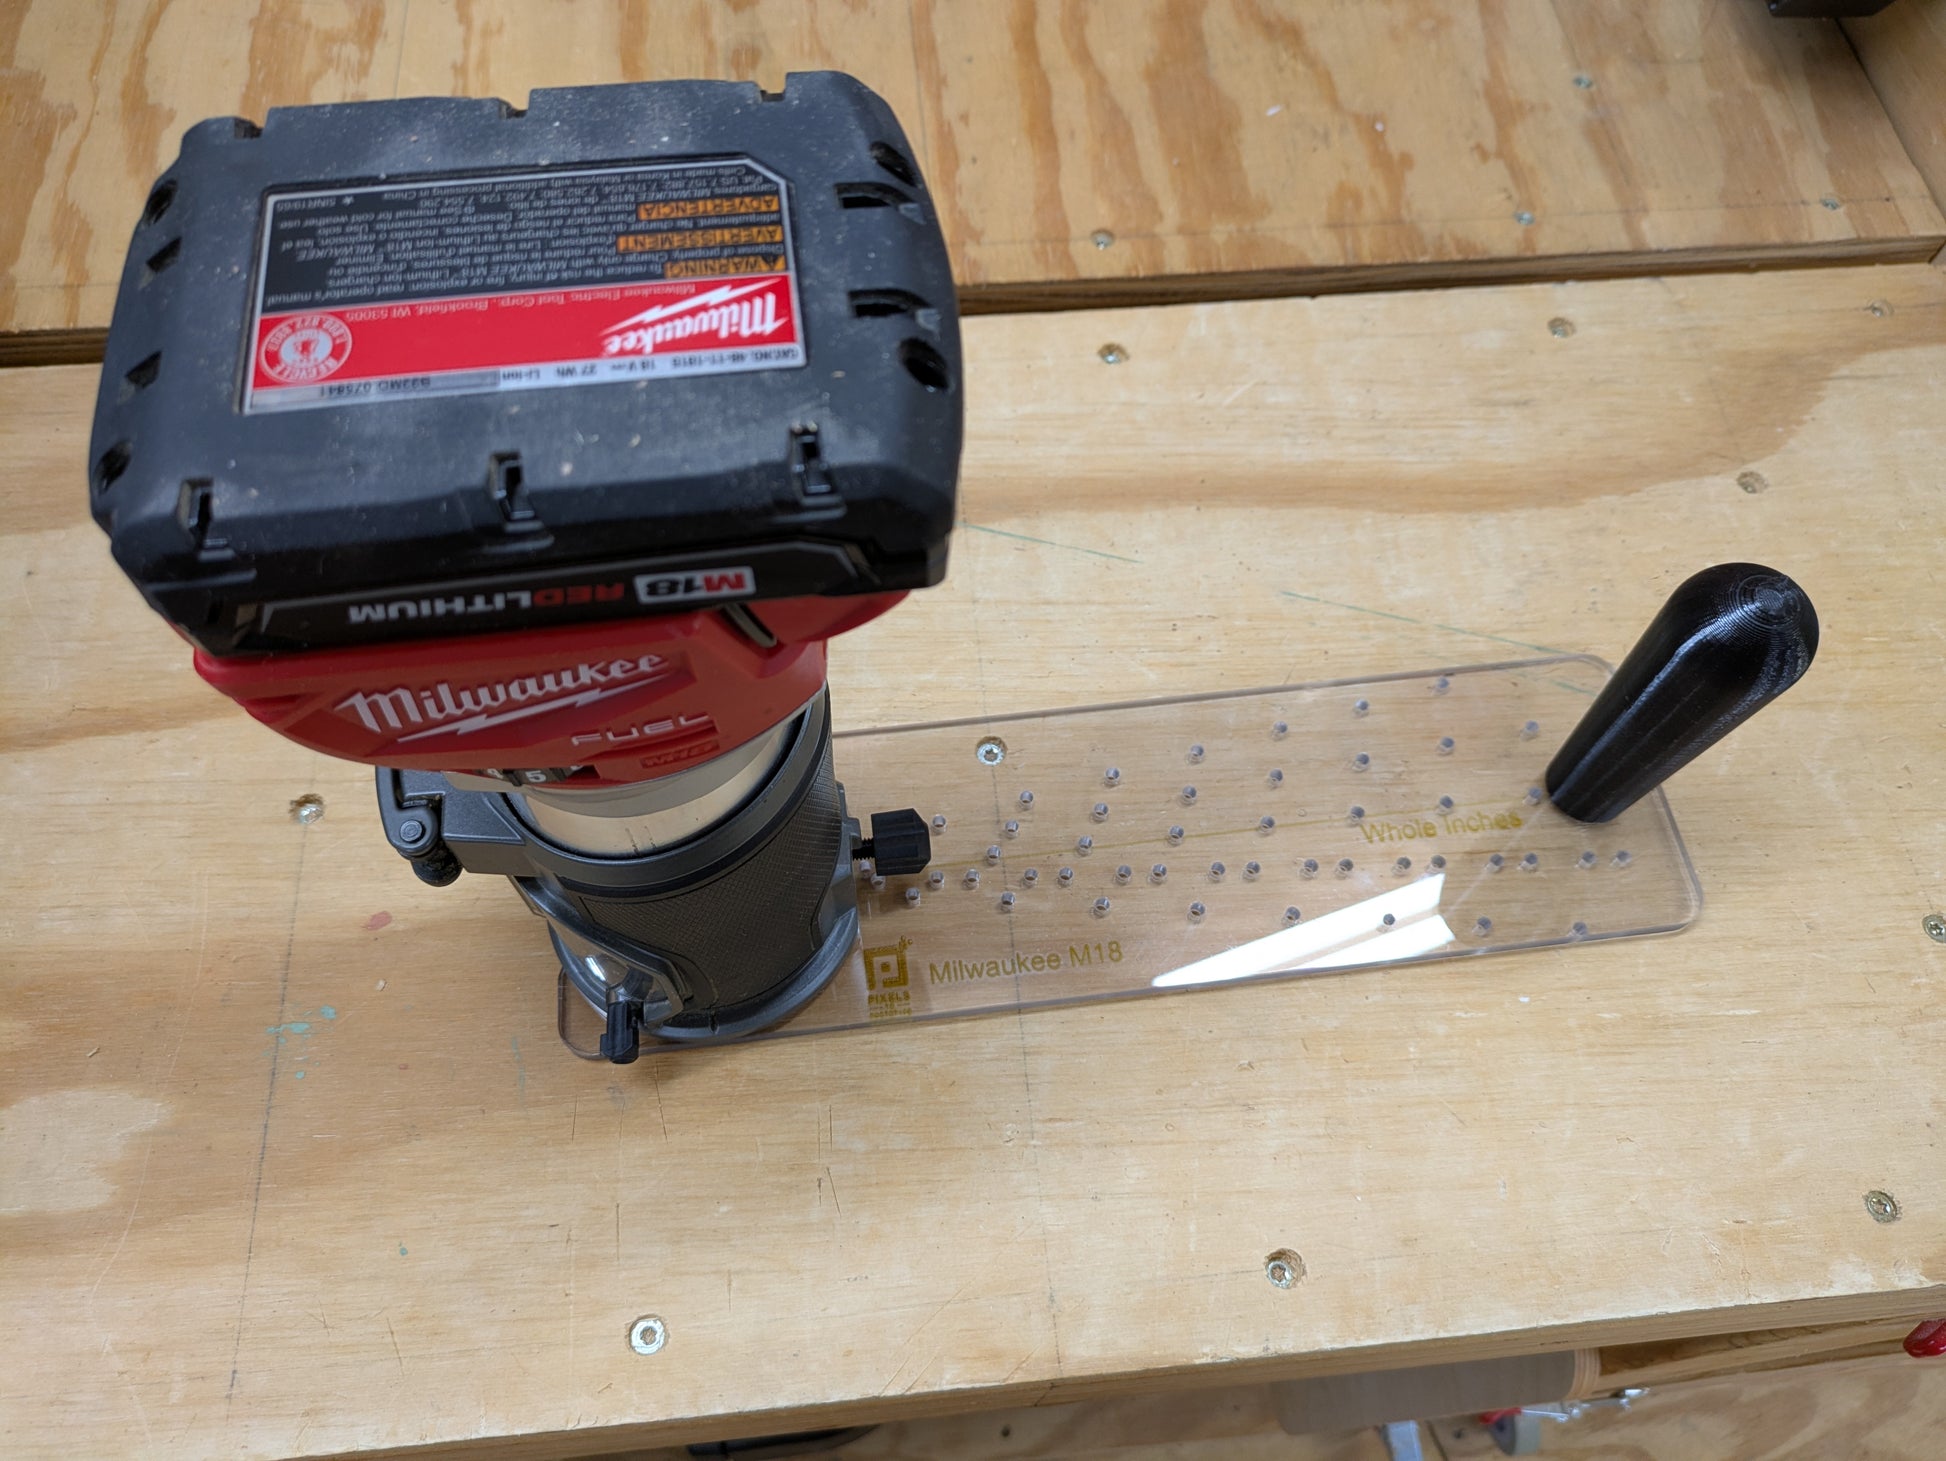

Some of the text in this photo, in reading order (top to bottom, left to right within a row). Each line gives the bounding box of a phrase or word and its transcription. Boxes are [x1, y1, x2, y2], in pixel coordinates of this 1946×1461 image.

[382, 164, 745, 201] Cells made in Korea or Malaysia with additional processing in China
[712, 181, 776, 195] cargadores
[583, 195, 599, 205] de
[637, 186, 711, 201] MILWAUKEE
[532, 199, 547, 209] de
[550, 196, 580, 208] iones
[593, 202, 635, 214] manual
[642, 195, 774, 219] ADVERTENCIA
[376, 211, 392, 222] for
[395, 208, 436, 220] manual
[439, 206, 461, 217] See
[572, 205, 590, 215] del
[302, 214, 348, 227] weather
[350, 212, 374, 224] cold
[461, 211, 512, 224] Deseche
[514, 218, 549, 230] riesgo
[552, 217, 563, 227] el
[566, 214, 606, 226] reducir
[608, 212, 636, 223] Para
[676, 217, 693, 228] Ne
[345, 222, 369, 233] Use
[496, 221, 511, 231] de
[562, 226, 579, 237] les
[581, 222, 627, 235] qu'avec
[629, 219, 674, 232] charger
[389, 227, 438, 240] incendio
[483, 232, 498, 243] au
[501, 228, 559, 242] chargeurs
[618, 226, 778, 253] AVERTISSEMENT
[281, 238, 293, 248] el
[295, 236, 314, 247] lea
[415, 234, 480, 248] Lithium-Ion
[505, 241, 515, 251] le
[518, 239, 540, 250] Lire
[459, 242, 501, 255] manuel
[589, 244, 615, 256] Pour
[722, 246, 735, 256] of
[737, 242, 784, 255] Dispose
[474, 254, 488, 265] de
[491, 251, 527, 264] risque
[530, 250, 540, 261] le
[597, 255, 622, 266] only
[625, 251, 667, 264] Charge
[346, 260, 407, 275] d'incendie
[489, 259, 567, 275] MILWAUKEE
[571, 257, 594, 268] with
[666, 255, 759, 277] WARNING
[328, 265, 344, 277] ou
[384, 268, 449, 283] Lithium-Ion
[545, 271, 558, 281] of
[560, 269, 581, 280] risk
[583, 267, 603, 278] the
[605, 264, 647, 276] reduce
[470, 277, 483, 287] or
[485, 275, 505, 286] fire
[314, 284, 374, 300] operator's
[377, 283, 404, 295] read
[570, 288, 620, 303] Electric
[624, 282, 696, 299] Milwaukee
[538, 293, 564, 306] Tool
[345, 307, 388, 321] 53005
[392, 305, 411, 318] WI
[603, 292, 788, 355] Milwaukee
[271, 355, 337, 382] RECYCLE
[555, 365, 577, 379] Wh
[581, 364, 597, 377] 27
[638, 359, 655, 372] 18
[501, 369, 540, 384] Li-Ion
[347, 571, 747, 625] M18 REDLITHIUM
[335, 653, 664, 734] Milwaukee
[571, 712, 710, 747] FUEL
[525, 769, 547, 783] 5
[1359, 811, 1524, 844] Whole Inches
[929, 940, 1125, 985] Milwaukee M18
[868, 989, 911, 1006] PIXELS
